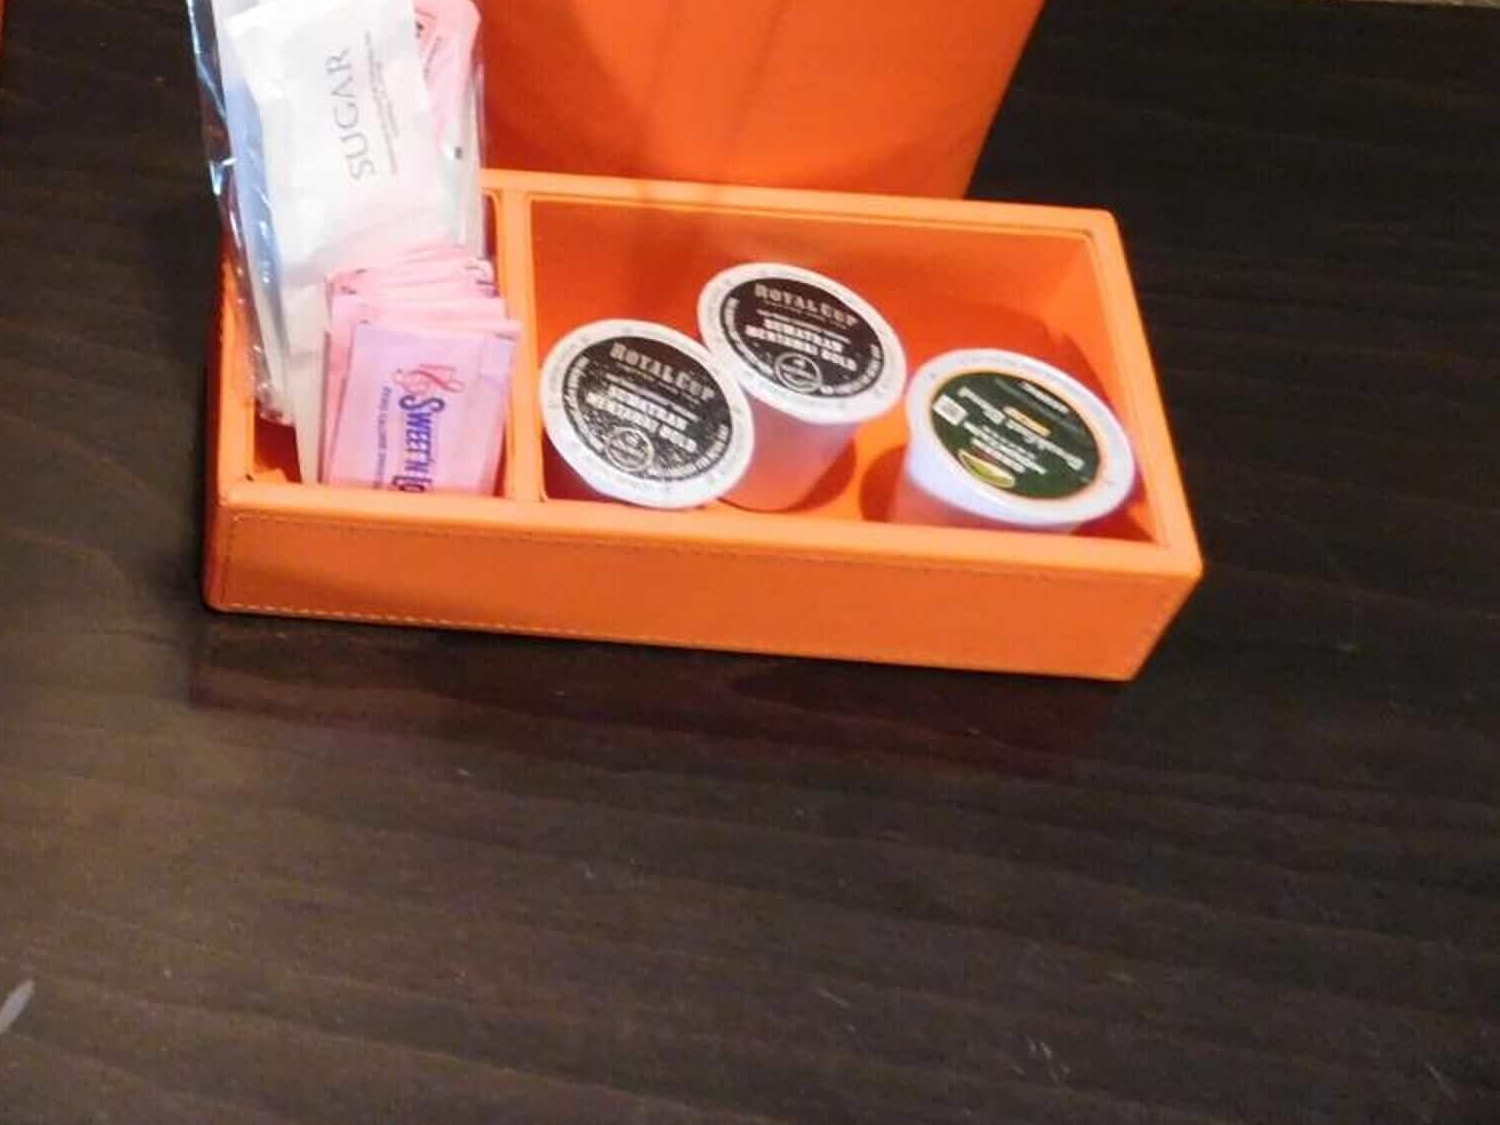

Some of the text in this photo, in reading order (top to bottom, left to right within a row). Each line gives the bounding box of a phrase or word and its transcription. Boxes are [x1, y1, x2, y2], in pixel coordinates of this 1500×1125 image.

[325, 47, 376, 180] SUGAR
[754, 282, 818, 313] ROYAL
[820, 302, 859, 327] CUP
[609, 341, 674, 385] ROYAL
[674, 371, 716, 402] CUP
